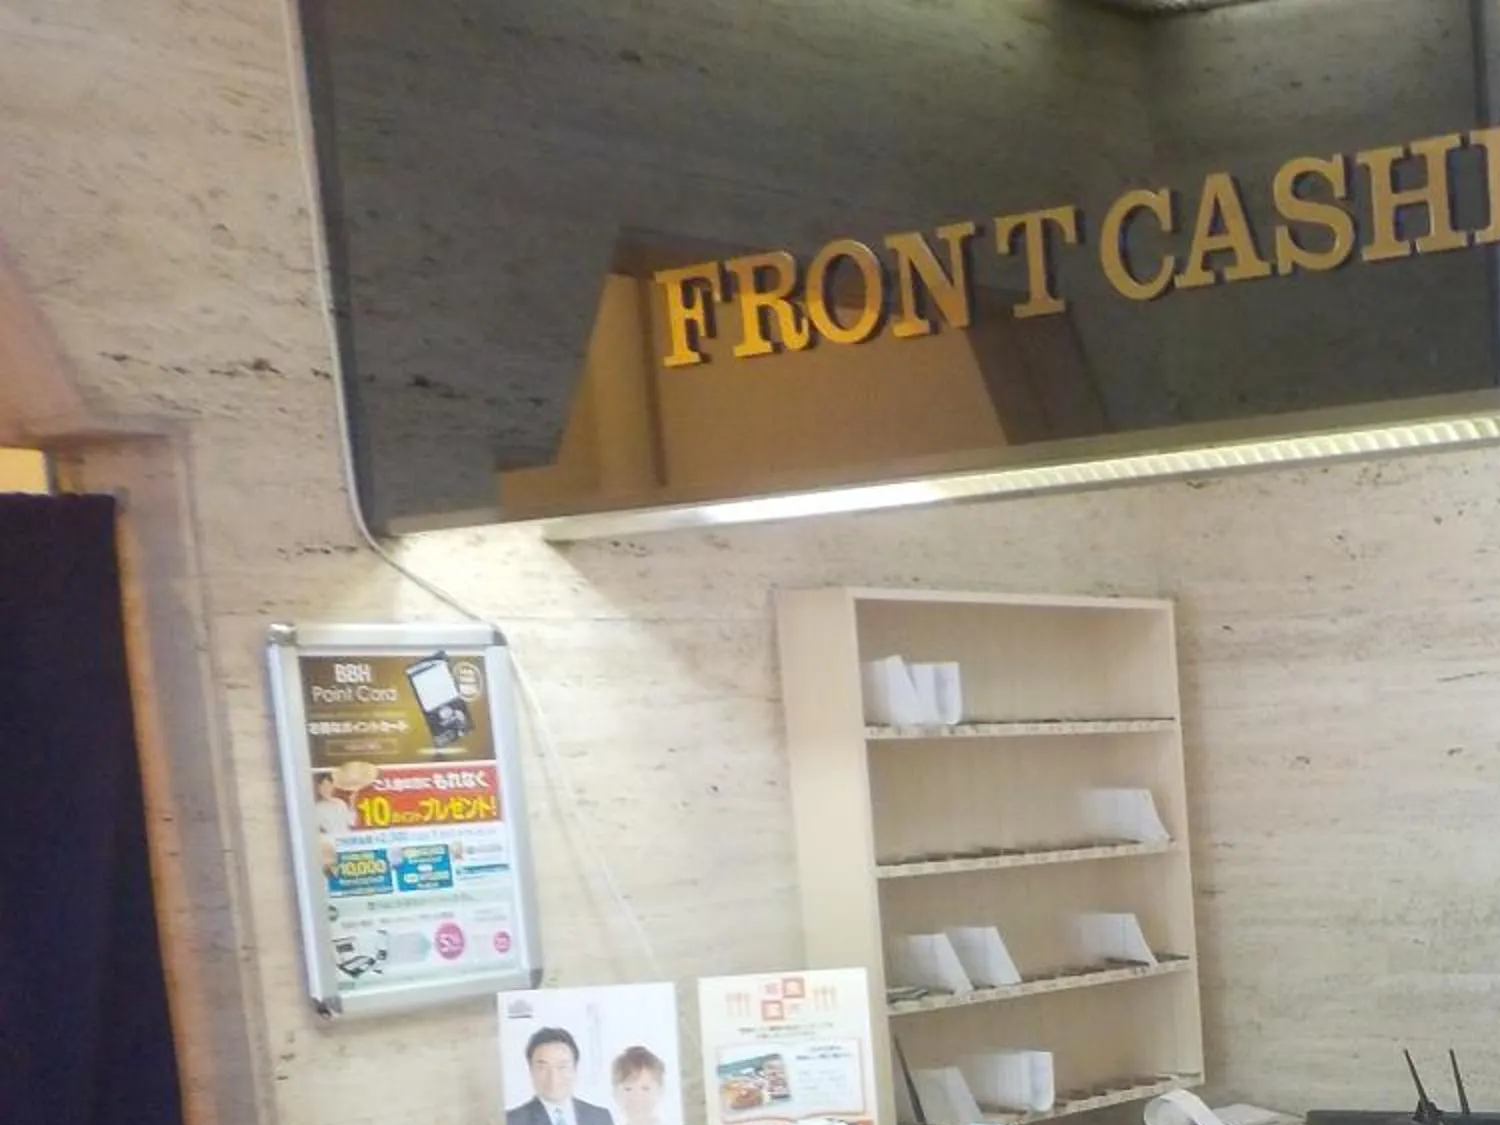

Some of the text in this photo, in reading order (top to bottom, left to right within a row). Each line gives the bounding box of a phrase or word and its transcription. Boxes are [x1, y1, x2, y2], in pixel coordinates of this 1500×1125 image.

[652, 205, 1080, 368] FRONT
[335, 663, 372, 683] BBH
[311, 685, 398, 703] Point Card
